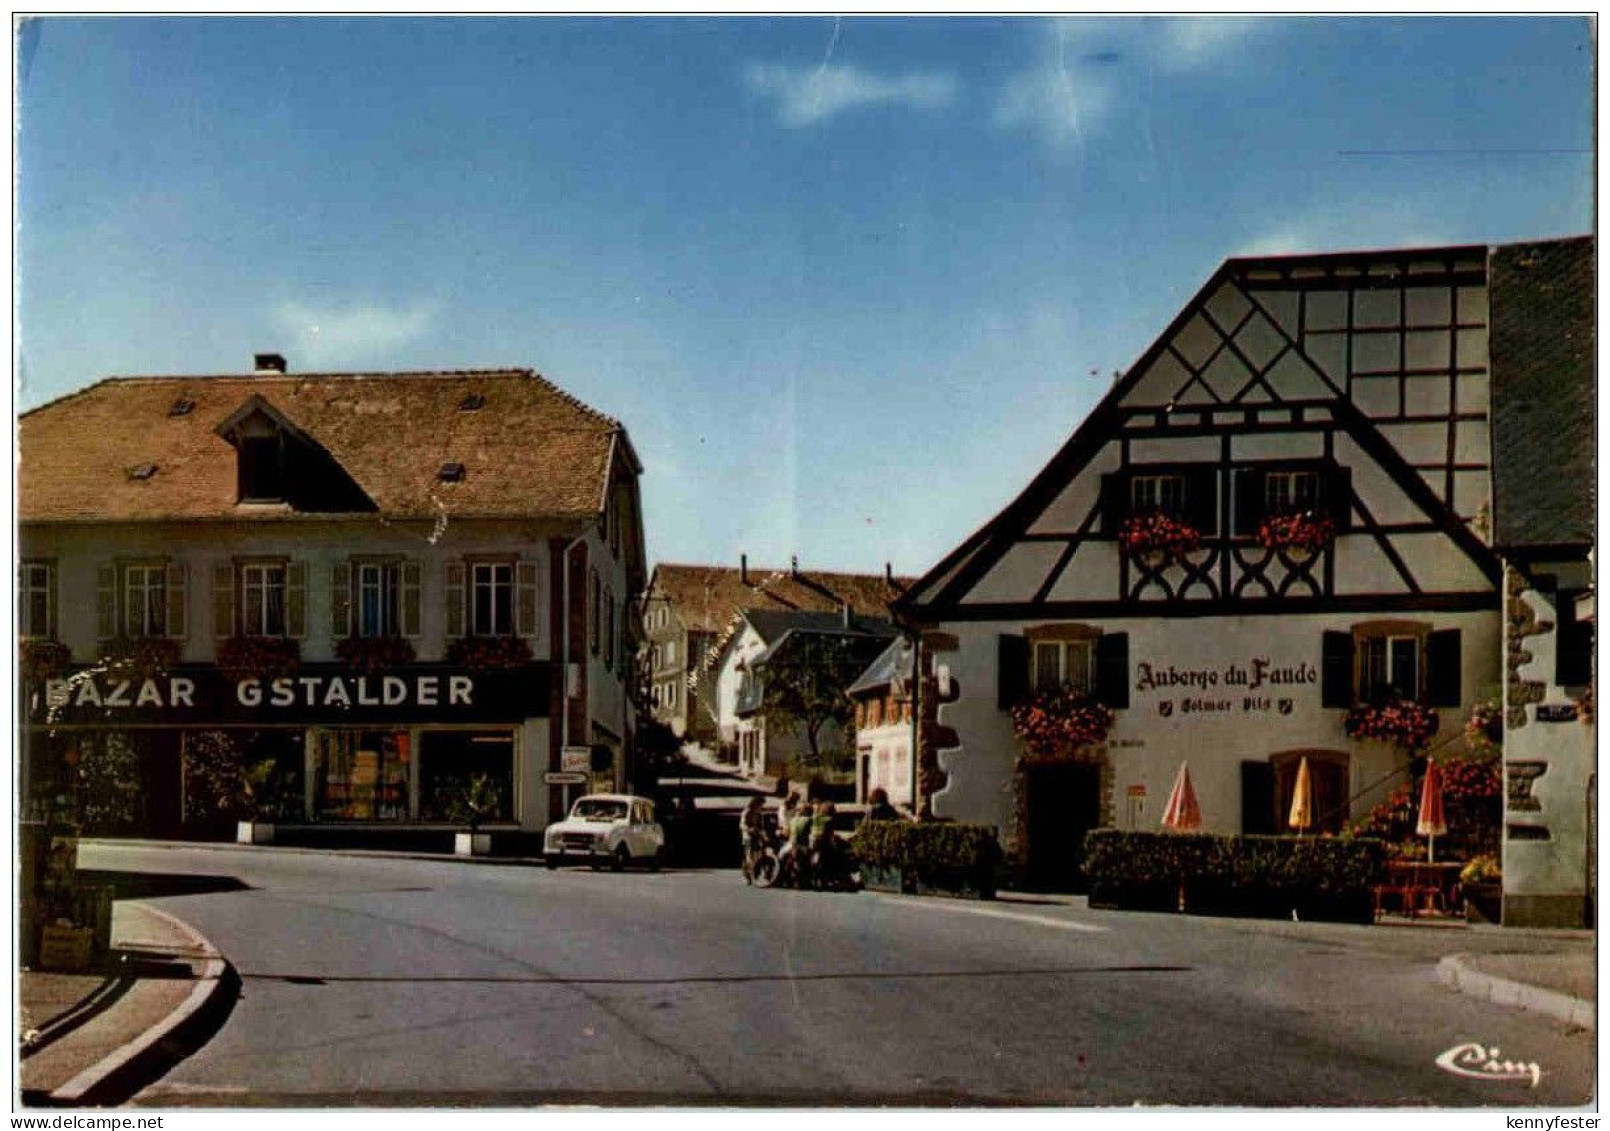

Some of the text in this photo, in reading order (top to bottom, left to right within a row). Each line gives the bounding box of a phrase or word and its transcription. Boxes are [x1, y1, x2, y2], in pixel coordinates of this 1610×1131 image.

[45, 676, 474, 706] BAZAR GSTALDER
[1136, 662, 1219, 691] Auberge
[1225, 665, 1248, 685] du
